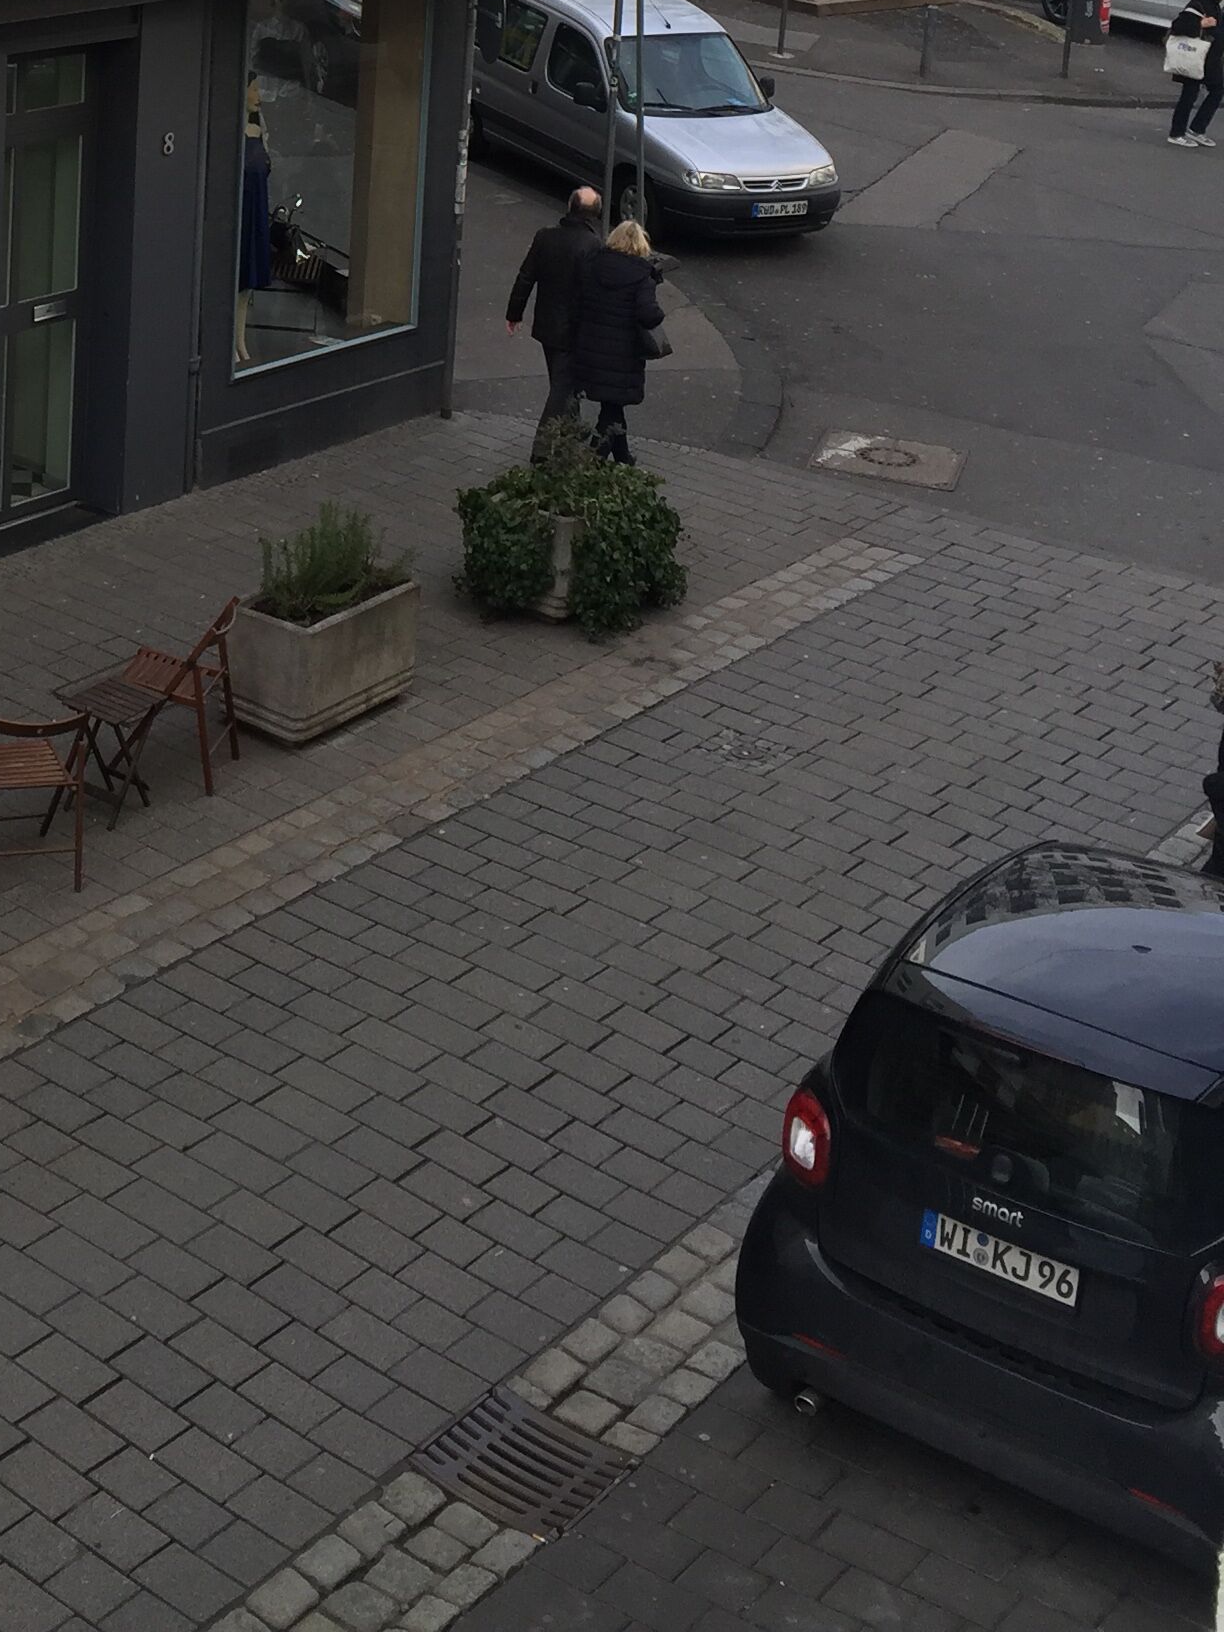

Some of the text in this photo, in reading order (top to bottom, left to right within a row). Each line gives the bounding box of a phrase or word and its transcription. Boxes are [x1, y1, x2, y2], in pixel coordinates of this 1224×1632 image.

[163, 132, 175, 155] 8
[972, 1196, 1025, 1228] smart
[939, 1217, 972, 1259] WI
[1038, 1259, 1075, 1299] 96
